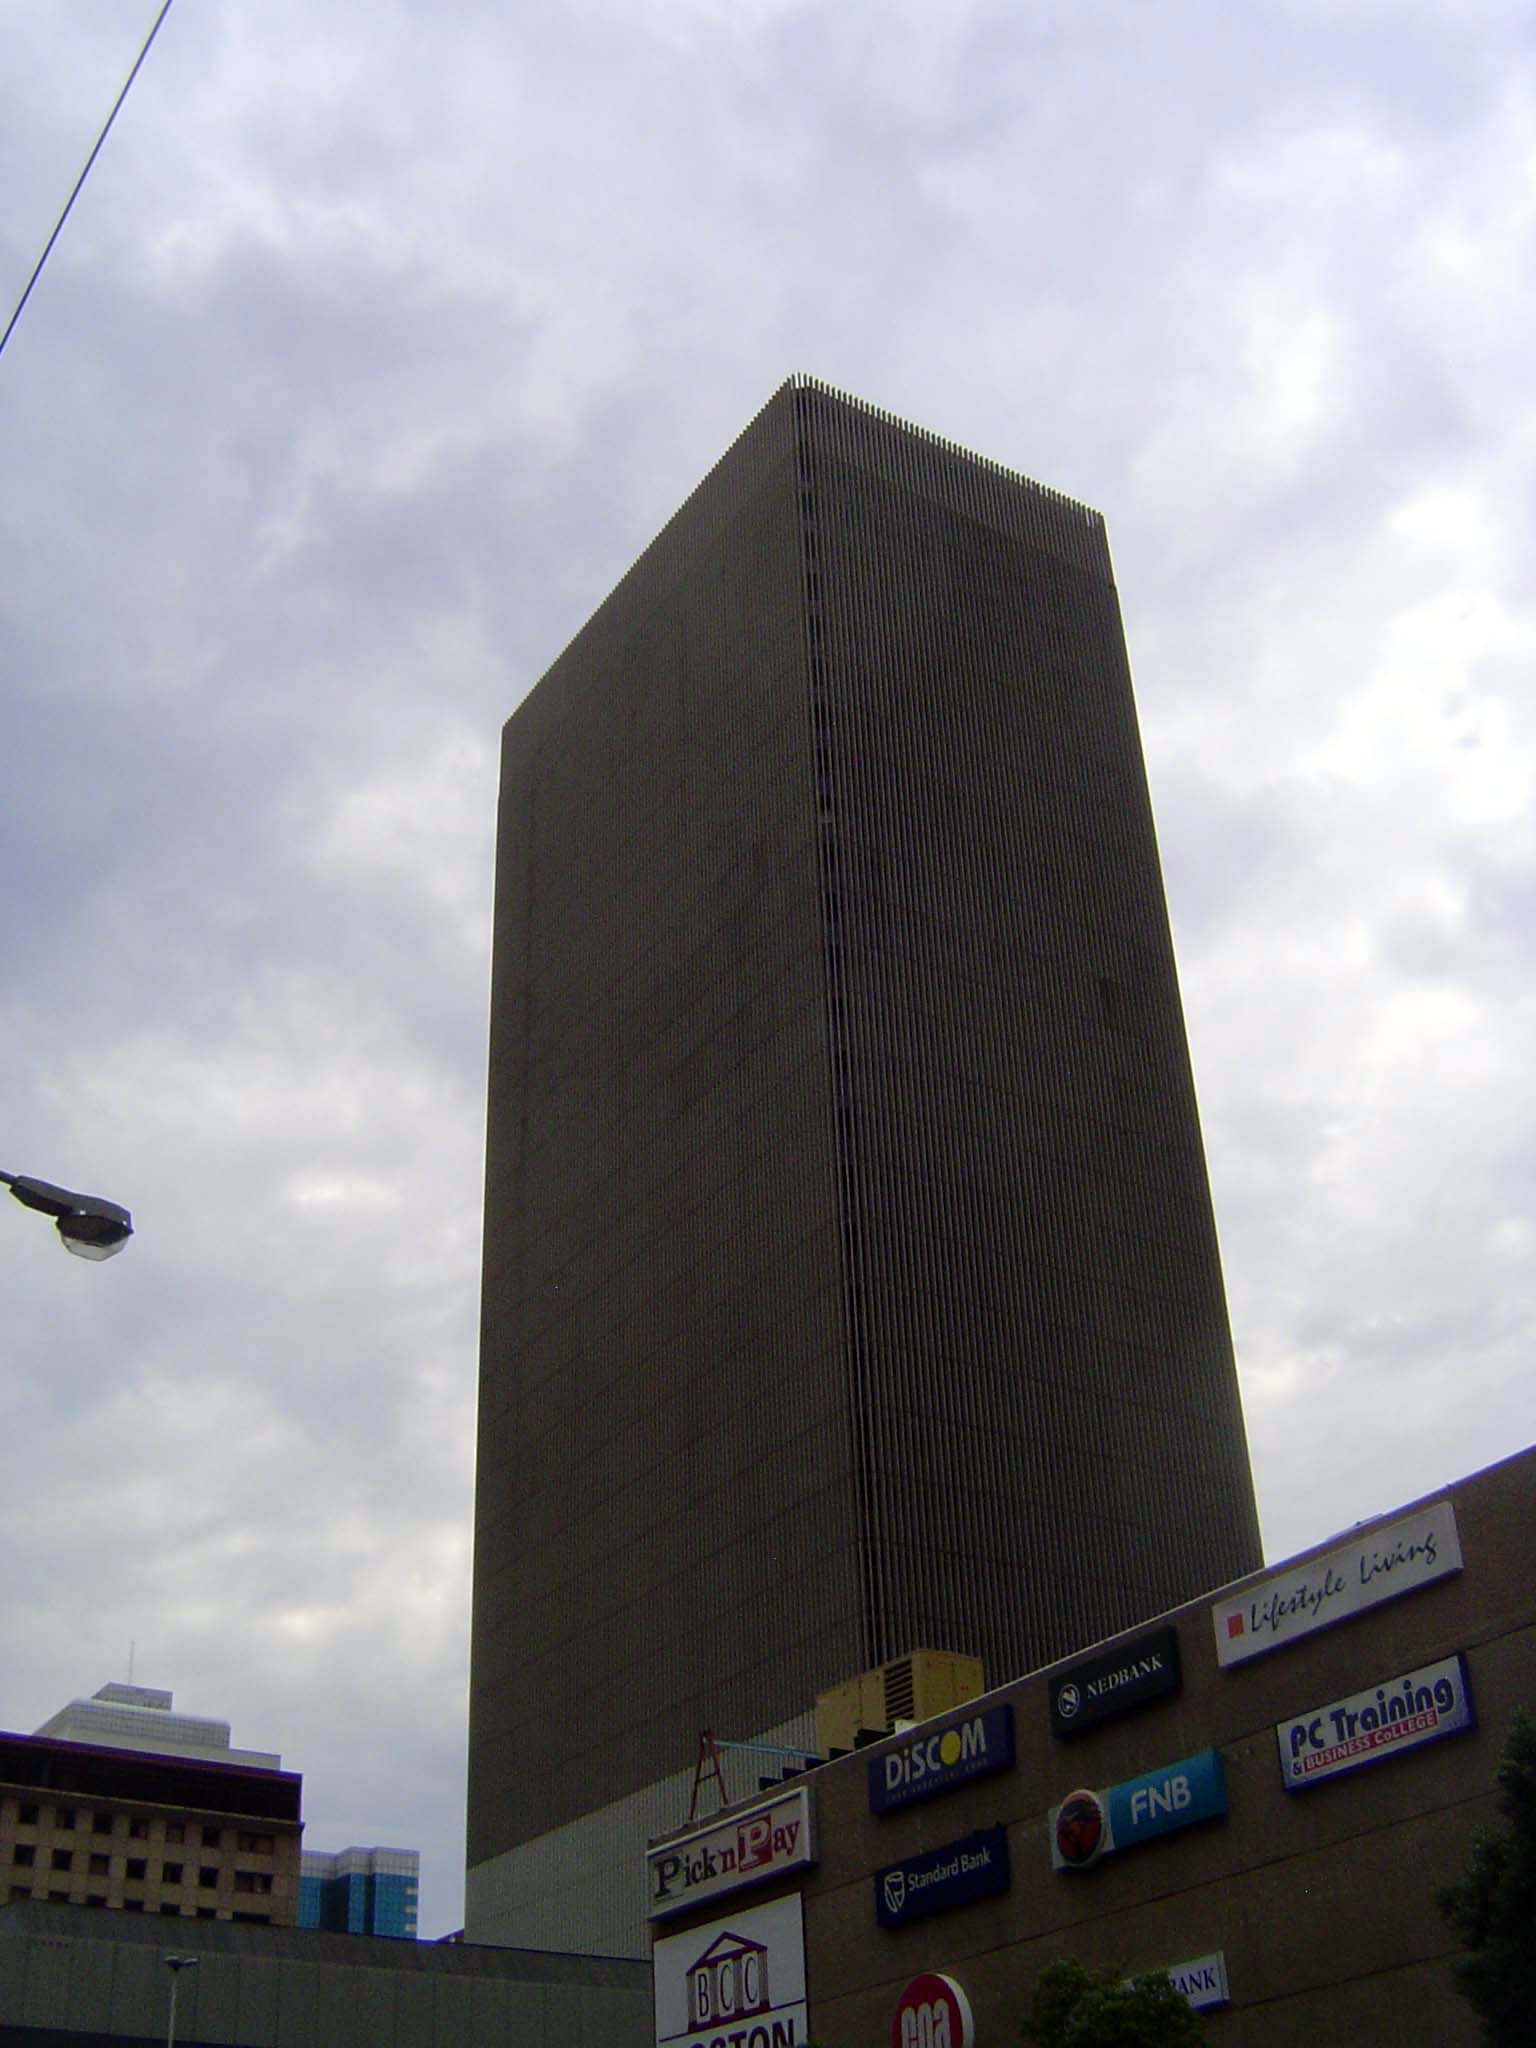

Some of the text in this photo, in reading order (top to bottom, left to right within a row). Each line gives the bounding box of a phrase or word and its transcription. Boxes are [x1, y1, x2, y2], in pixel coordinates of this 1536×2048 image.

[1250, 1532, 1438, 1632] Lifestyle Living
[1086, 1651, 1163, 1699] NEDBANK
[1290, 1678, 1454, 1758] PC Training
[1305, 1733, 1371, 1771] BUSINESS
[1130, 1775, 1192, 1825] FNB
[655, 1818, 800, 1899] Pick n Pay
[906, 1847, 992, 1893] Standard Bank
[697, 1956, 759, 2017] BCC
